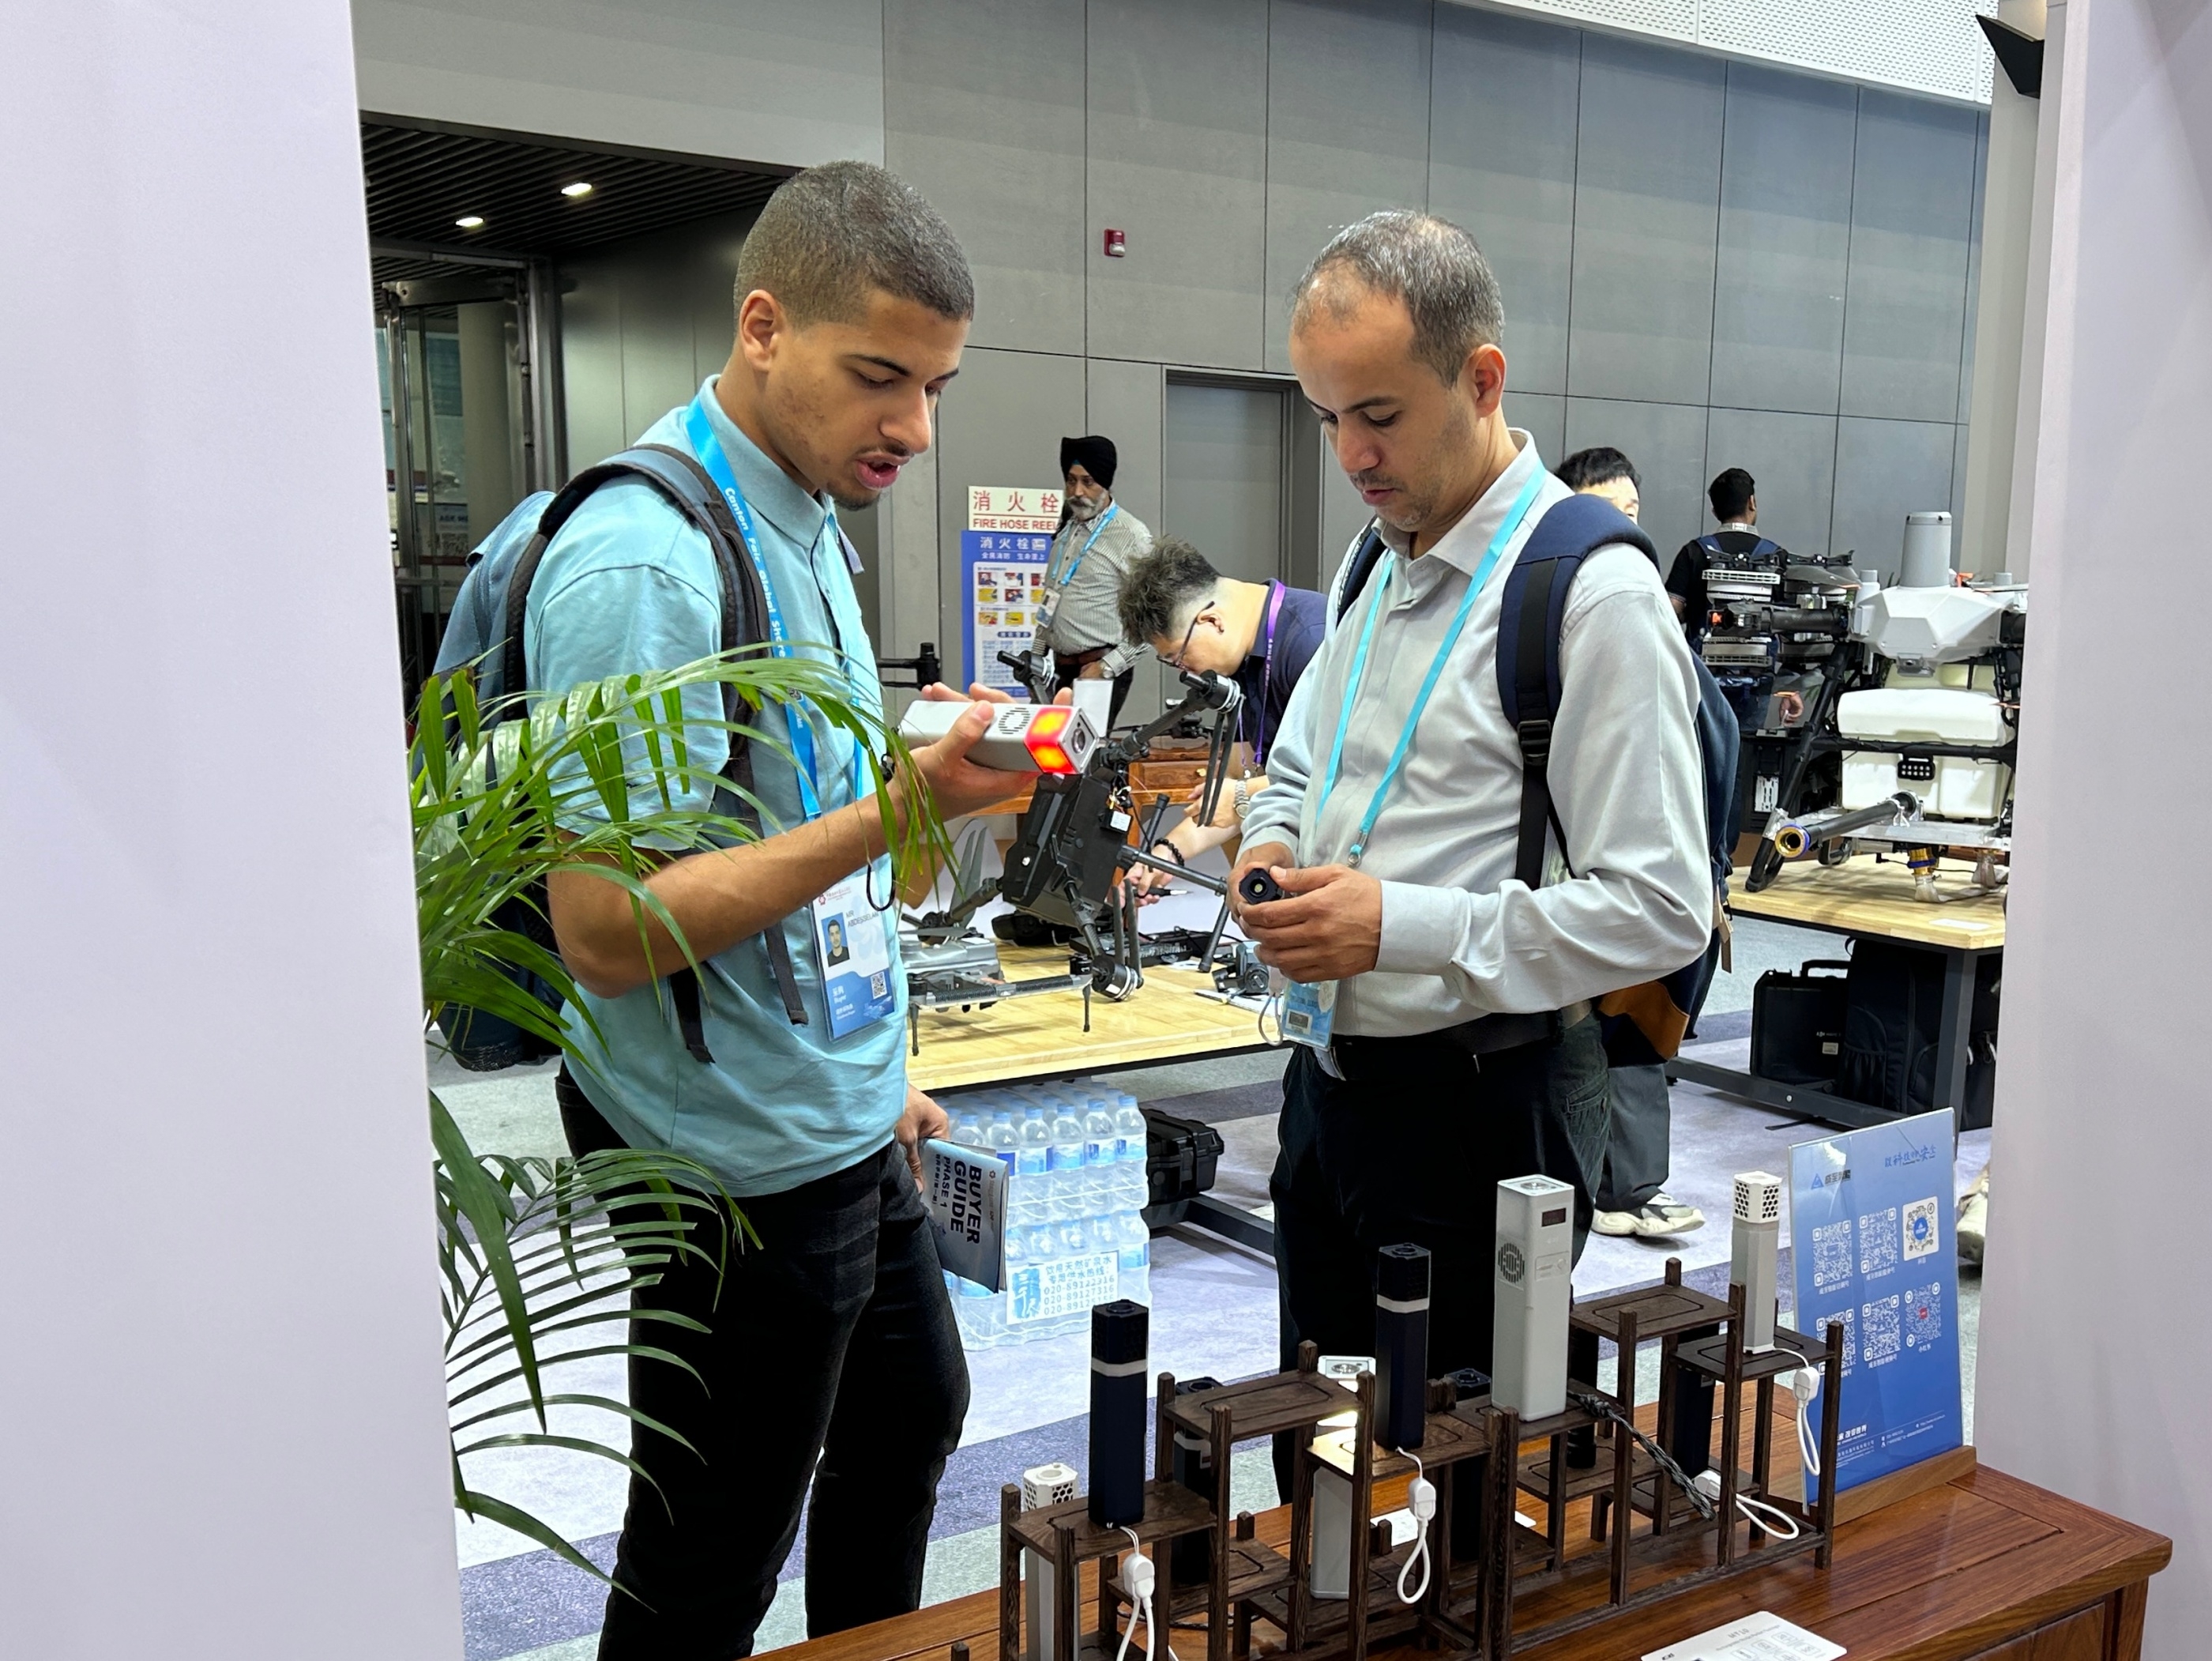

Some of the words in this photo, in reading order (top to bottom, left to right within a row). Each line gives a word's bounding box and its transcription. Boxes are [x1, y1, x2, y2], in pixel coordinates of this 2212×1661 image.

[972, 491, 1059, 514] 消火栓
[972, 518, 997, 529] FIRE
[999, 519, 1029, 529] HOSE
[724, 487, 749, 530] Canton
[747, 537, 761, 563] Fair
[758, 570, 777, 613] Global
[980, 537, 1029, 550] 消火栓
[940, 1156, 951, 1198] PHASE
[950, 1160, 967, 1234] GUIDE
[966, 1165, 983, 1244] BUYER
[1044, 1275, 1115, 1295] 020-89122316
[1044, 1284, 1115, 1305] 020-89127316
